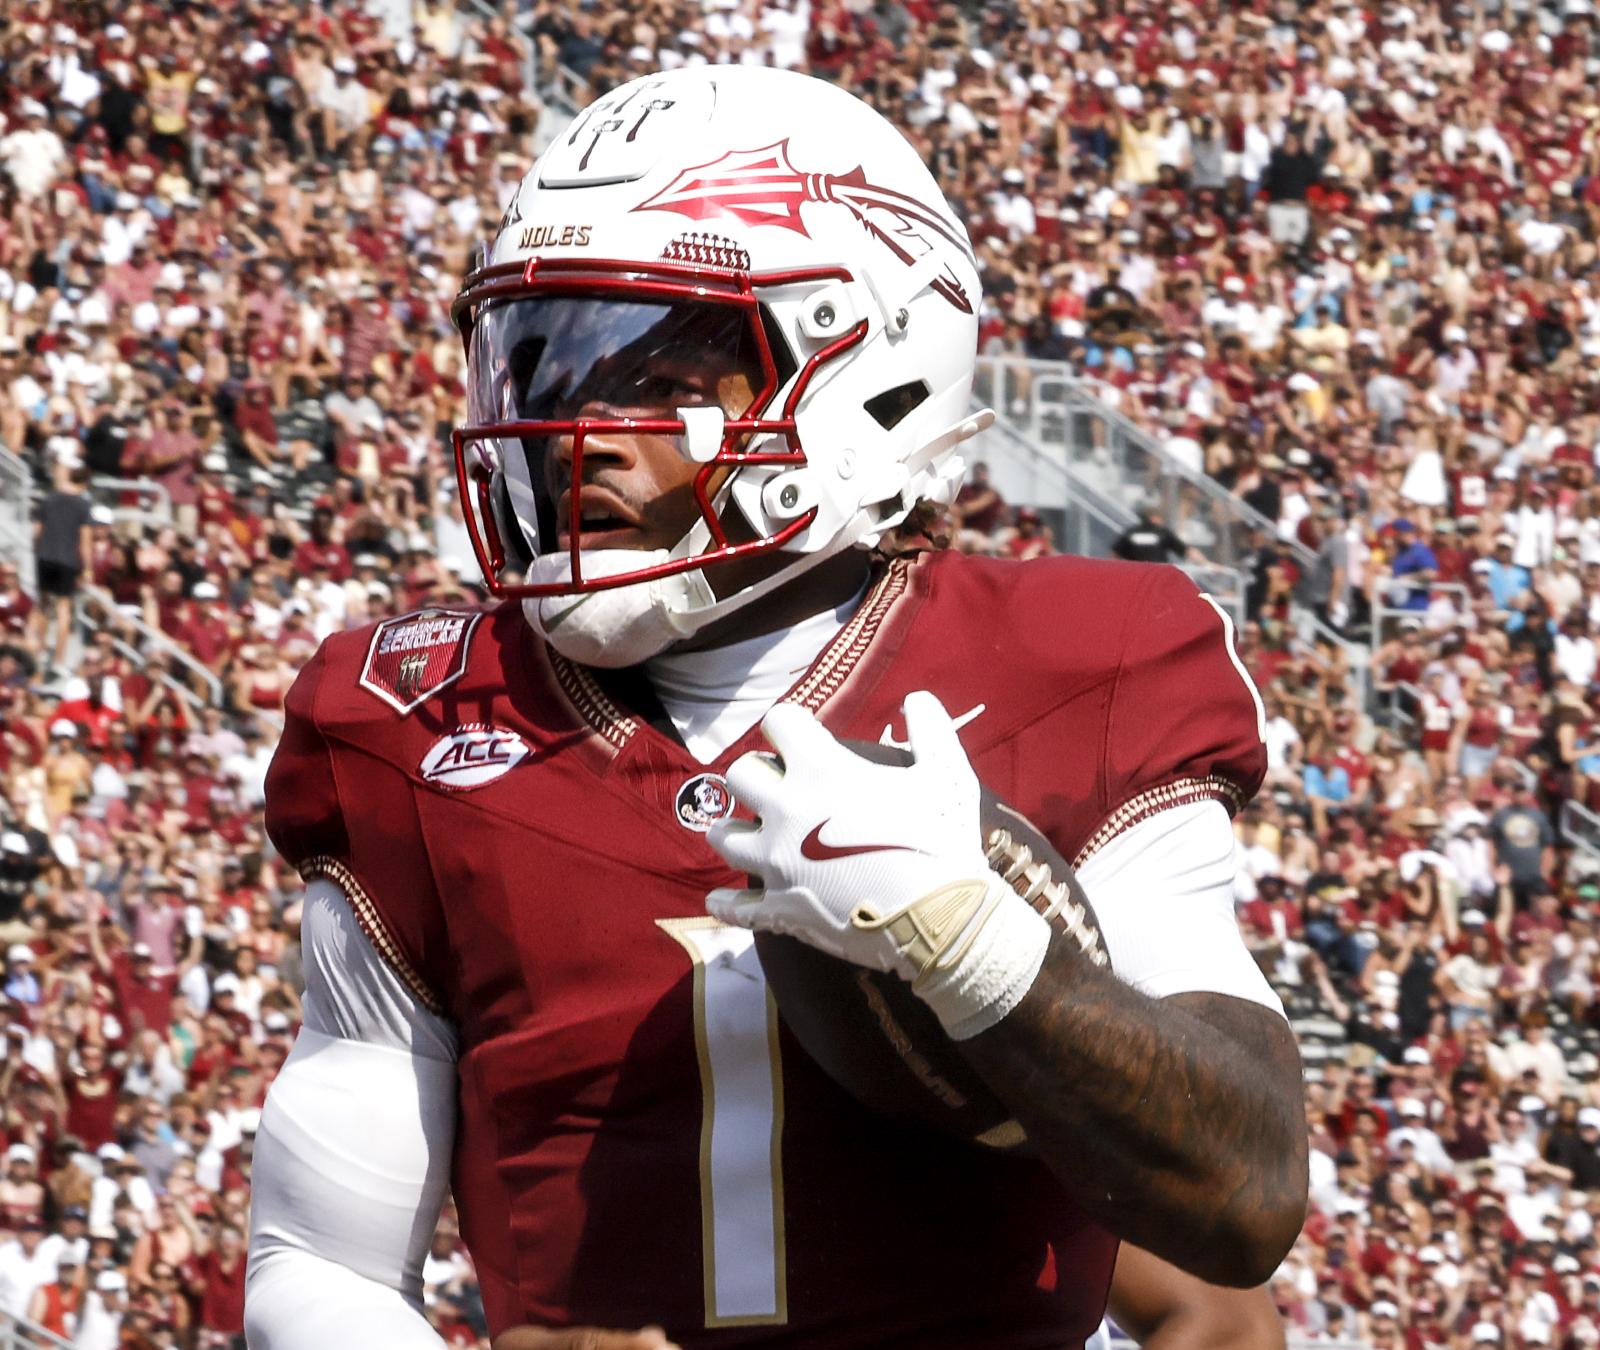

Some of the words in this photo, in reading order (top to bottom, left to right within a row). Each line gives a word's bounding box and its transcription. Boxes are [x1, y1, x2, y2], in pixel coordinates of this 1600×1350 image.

[518, 225, 592, 250] NOLES
[379, 628, 463, 655] SCHOLAR
[433, 737, 512, 770] ACC
[654, 915, 789, 1329] 1
